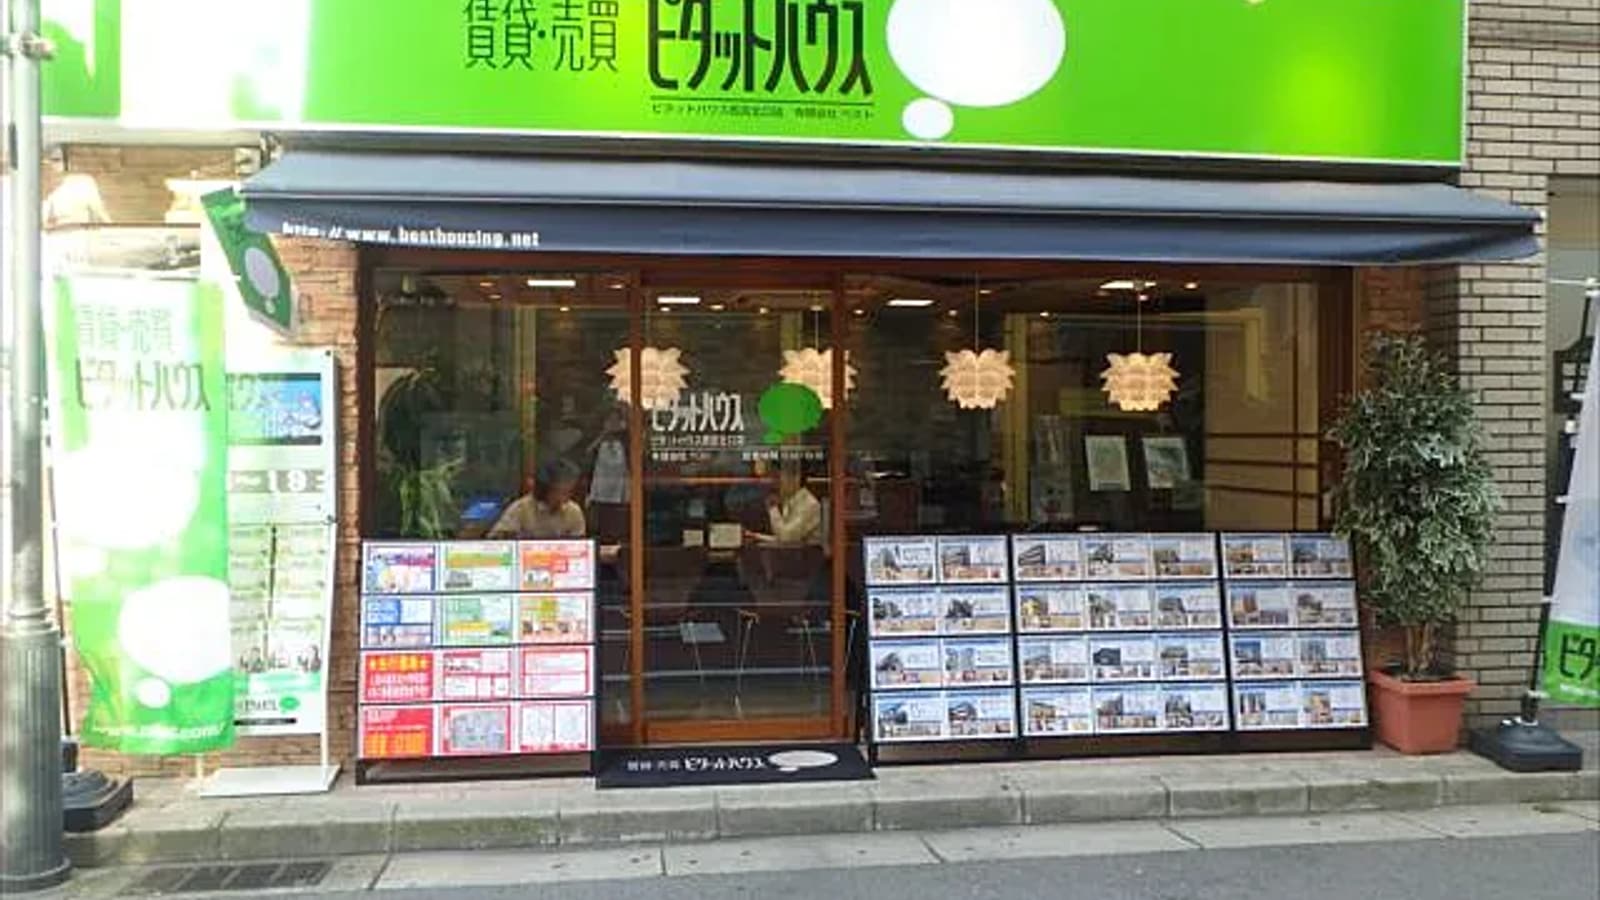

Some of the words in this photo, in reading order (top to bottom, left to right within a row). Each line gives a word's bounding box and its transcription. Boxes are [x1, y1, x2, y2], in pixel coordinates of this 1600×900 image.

[648, 0, 874, 94] ピタットハウス
[1560, 632, 1600, 681] ピタ
